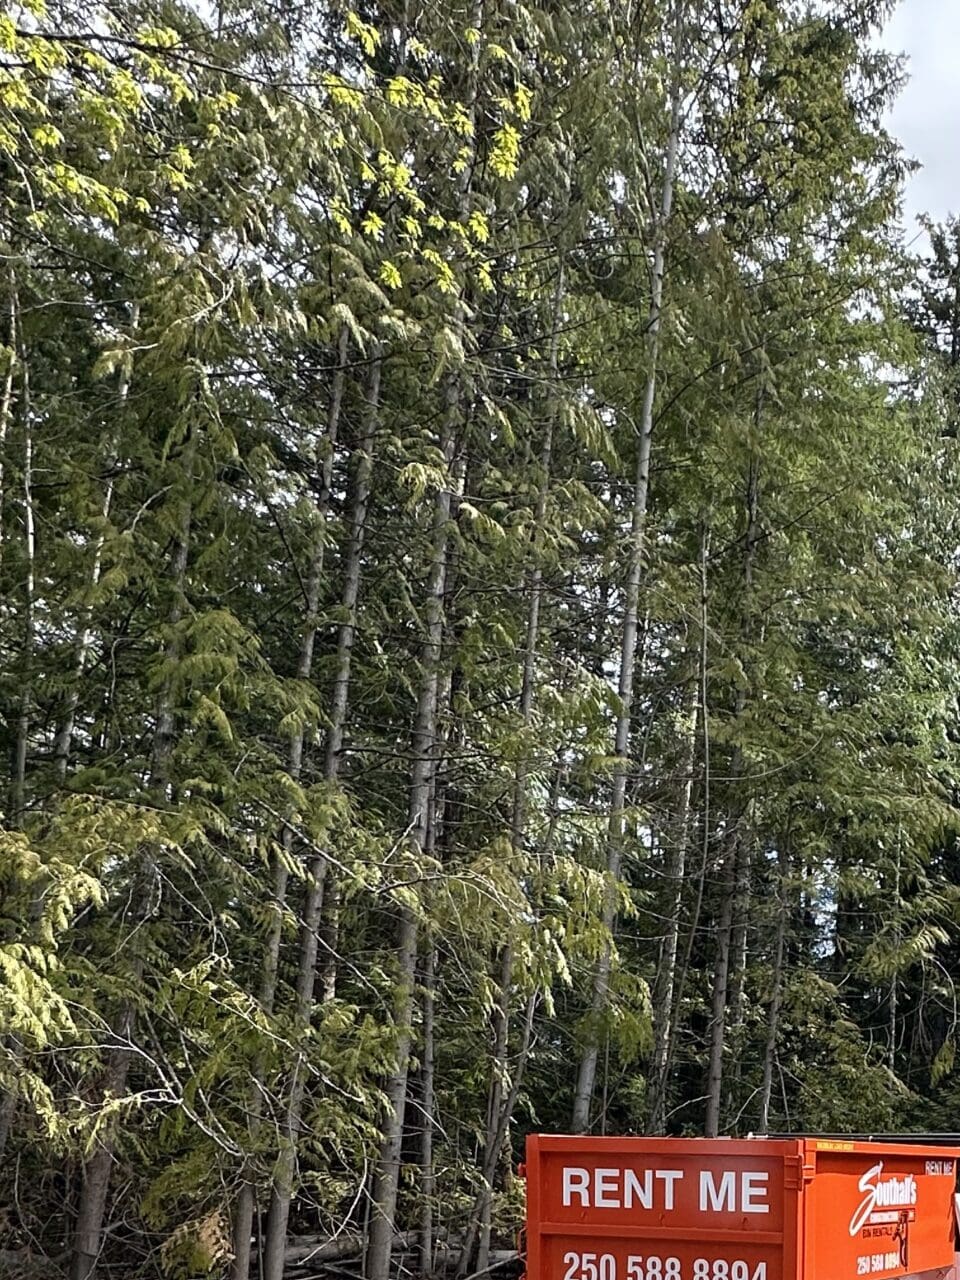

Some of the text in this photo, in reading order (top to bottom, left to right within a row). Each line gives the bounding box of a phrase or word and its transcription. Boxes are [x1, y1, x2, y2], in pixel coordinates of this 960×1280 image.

[925, 1161, 953, 1176] RENT ME
[562, 1167, 770, 1213] RENT ME
[848, 1160, 917, 1237] Southall's
[856, 1255, 871, 1275] 250
